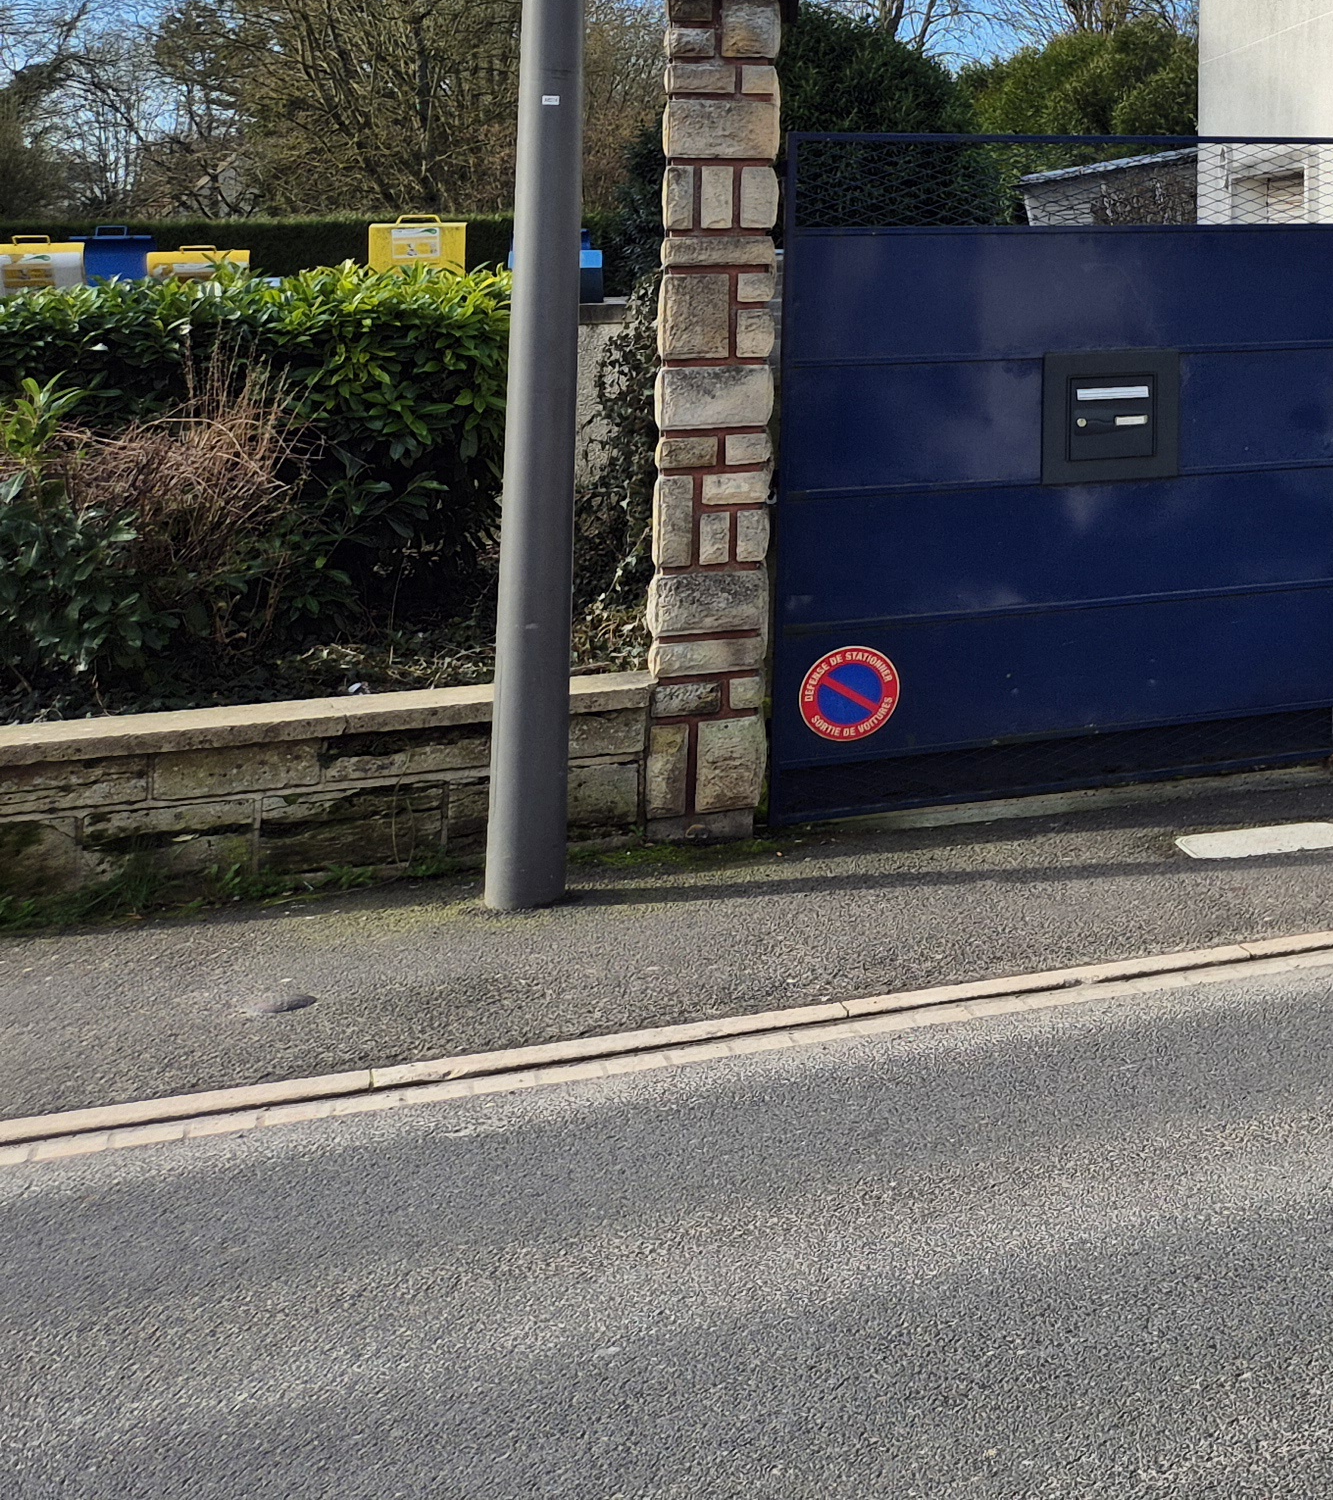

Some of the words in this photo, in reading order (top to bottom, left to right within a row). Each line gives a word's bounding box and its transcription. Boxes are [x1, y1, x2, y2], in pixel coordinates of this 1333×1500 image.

[805, 662, 830, 702] DEFENSE
[829, 653, 844, 666] DE
[811, 715, 842, 737] SORTIE
[843, 727, 857, 737] DE
[857, 697, 893, 733] VOITURES
